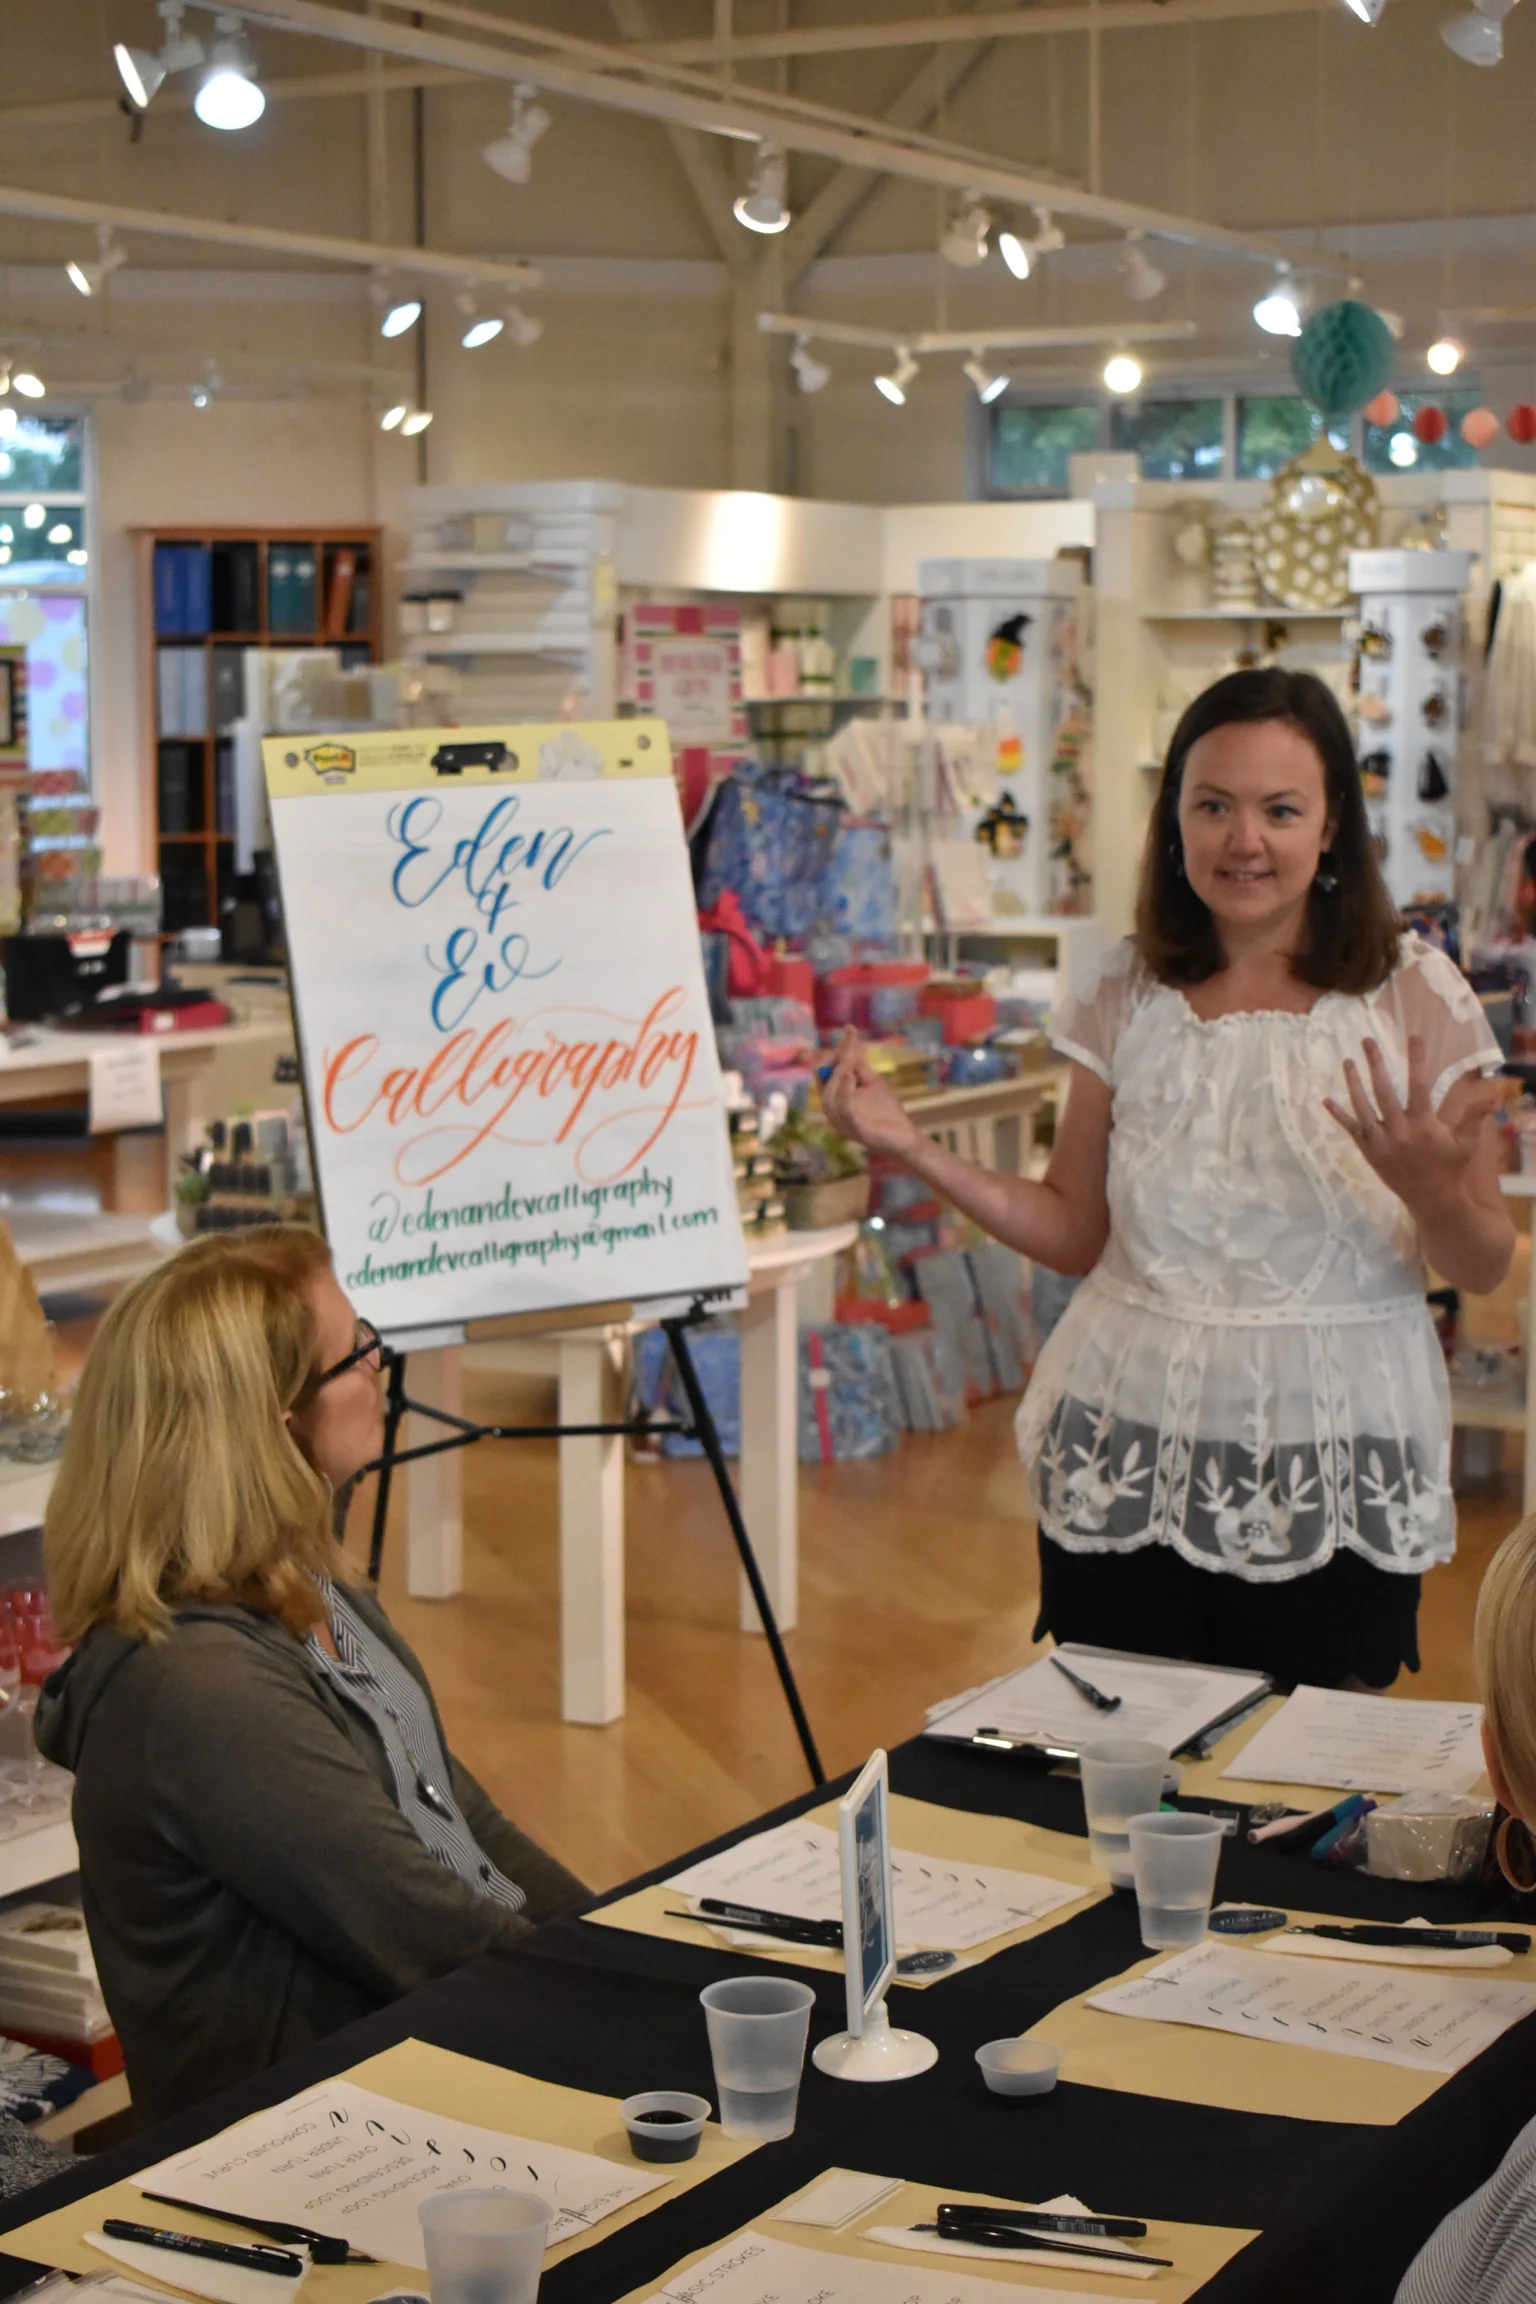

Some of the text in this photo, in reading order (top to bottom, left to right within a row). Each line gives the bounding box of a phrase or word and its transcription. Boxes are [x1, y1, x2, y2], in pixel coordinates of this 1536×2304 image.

[386, 795, 613, 908] Eden
[322, 985, 716, 1187] Calligraphy
[246, 2122, 317, 2159] COMPOUND
[270, 2135, 349, 2175] UNDER TURN
[202, 2157, 248, 2180] CURVE
[308, 2145, 378, 2180] OVER TURN
[304, 2156, 414, 2210] DESCENDING LOOP
[341, 2165, 440, 2215] ASCENDING LOOP
[435, 2174, 472, 2190] OVAL
[604, 2186, 635, 2199] THE
[708, 2245, 766, 2279] STROKES
